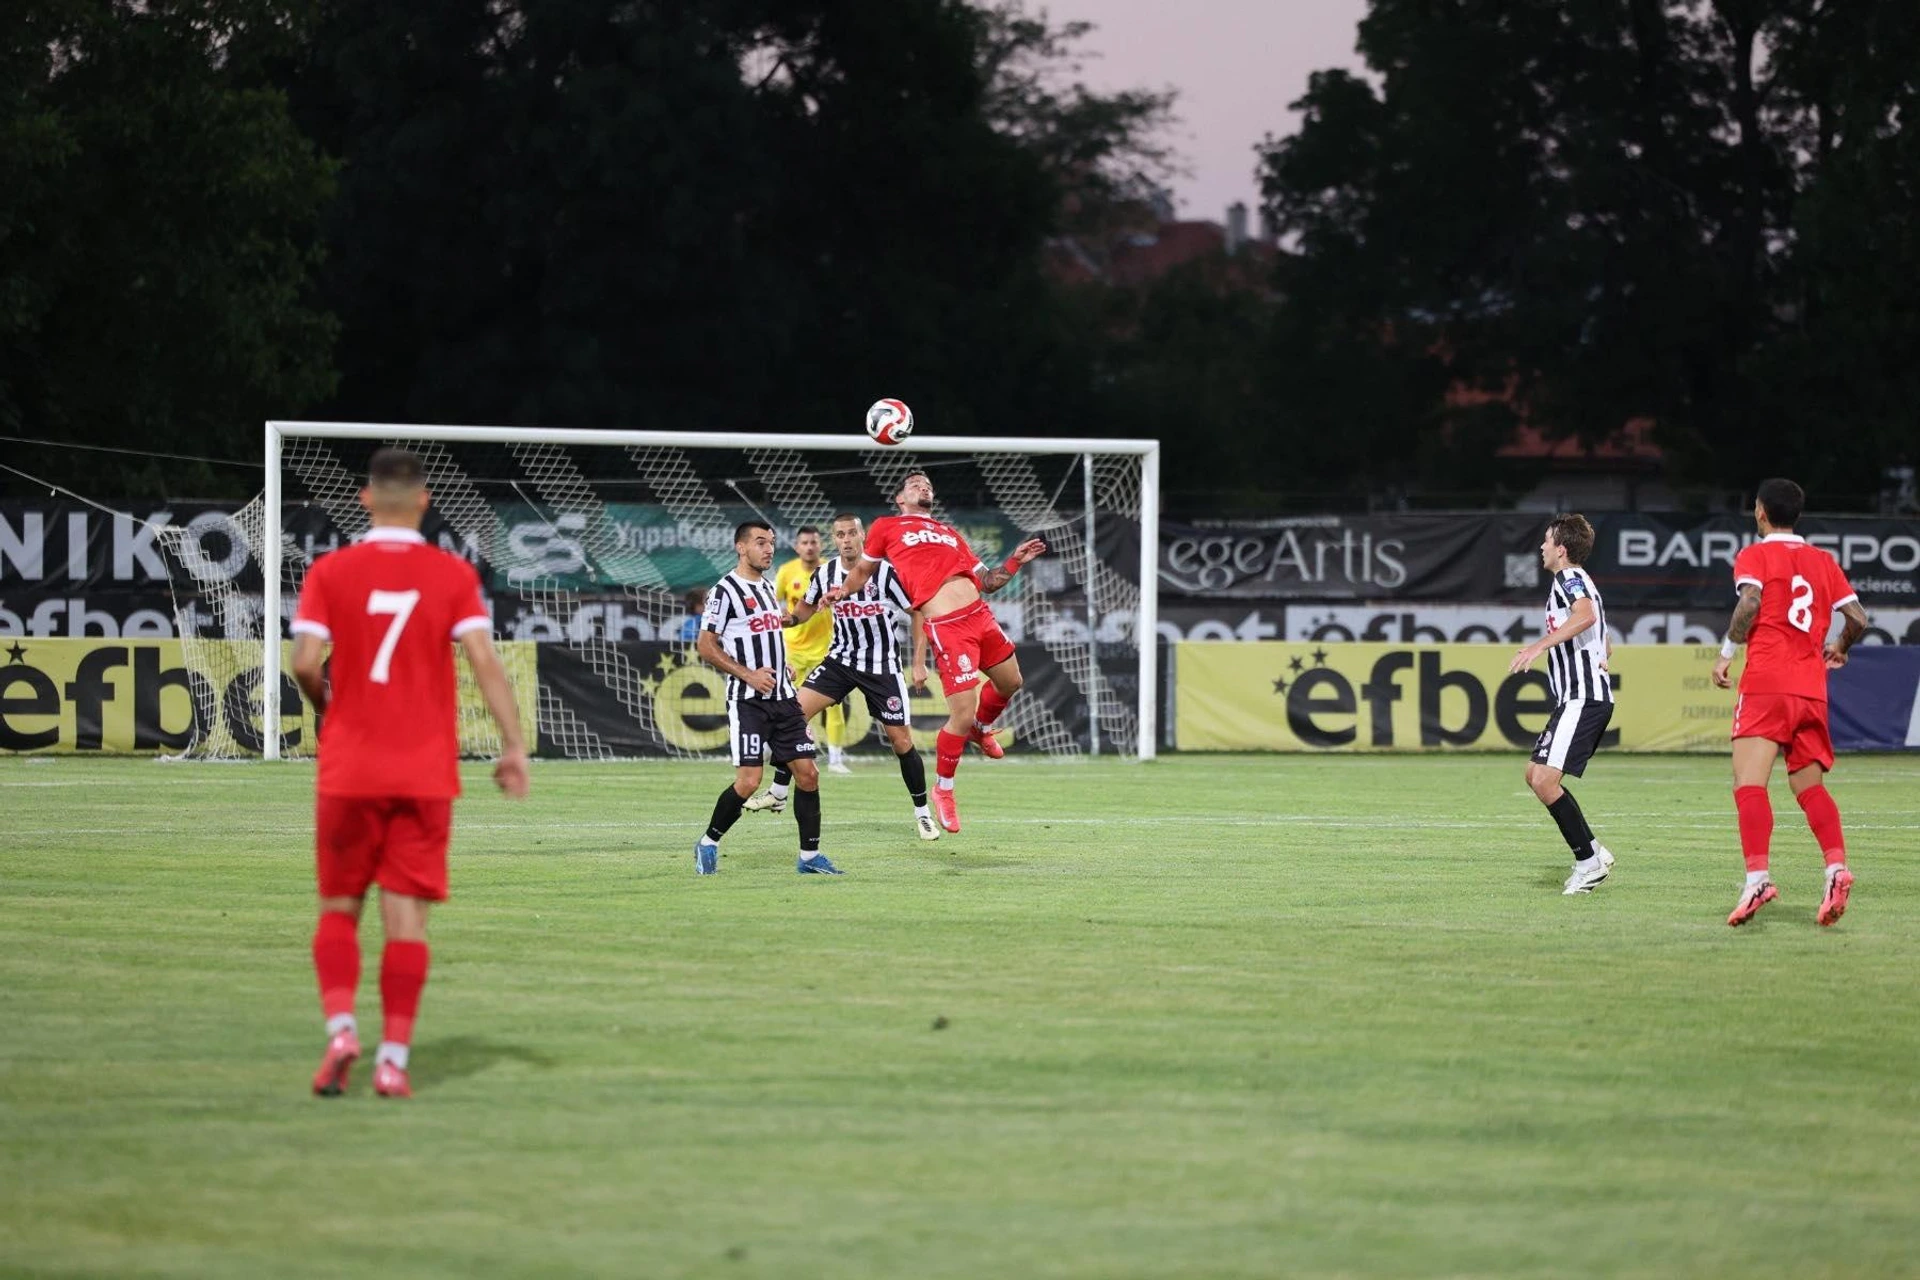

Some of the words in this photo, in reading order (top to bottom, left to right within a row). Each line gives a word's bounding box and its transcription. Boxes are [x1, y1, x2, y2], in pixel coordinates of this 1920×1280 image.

[1787, 575, 1813, 633] 8
[367, 589, 421, 684] 7
[742, 733, 761, 755] 19
